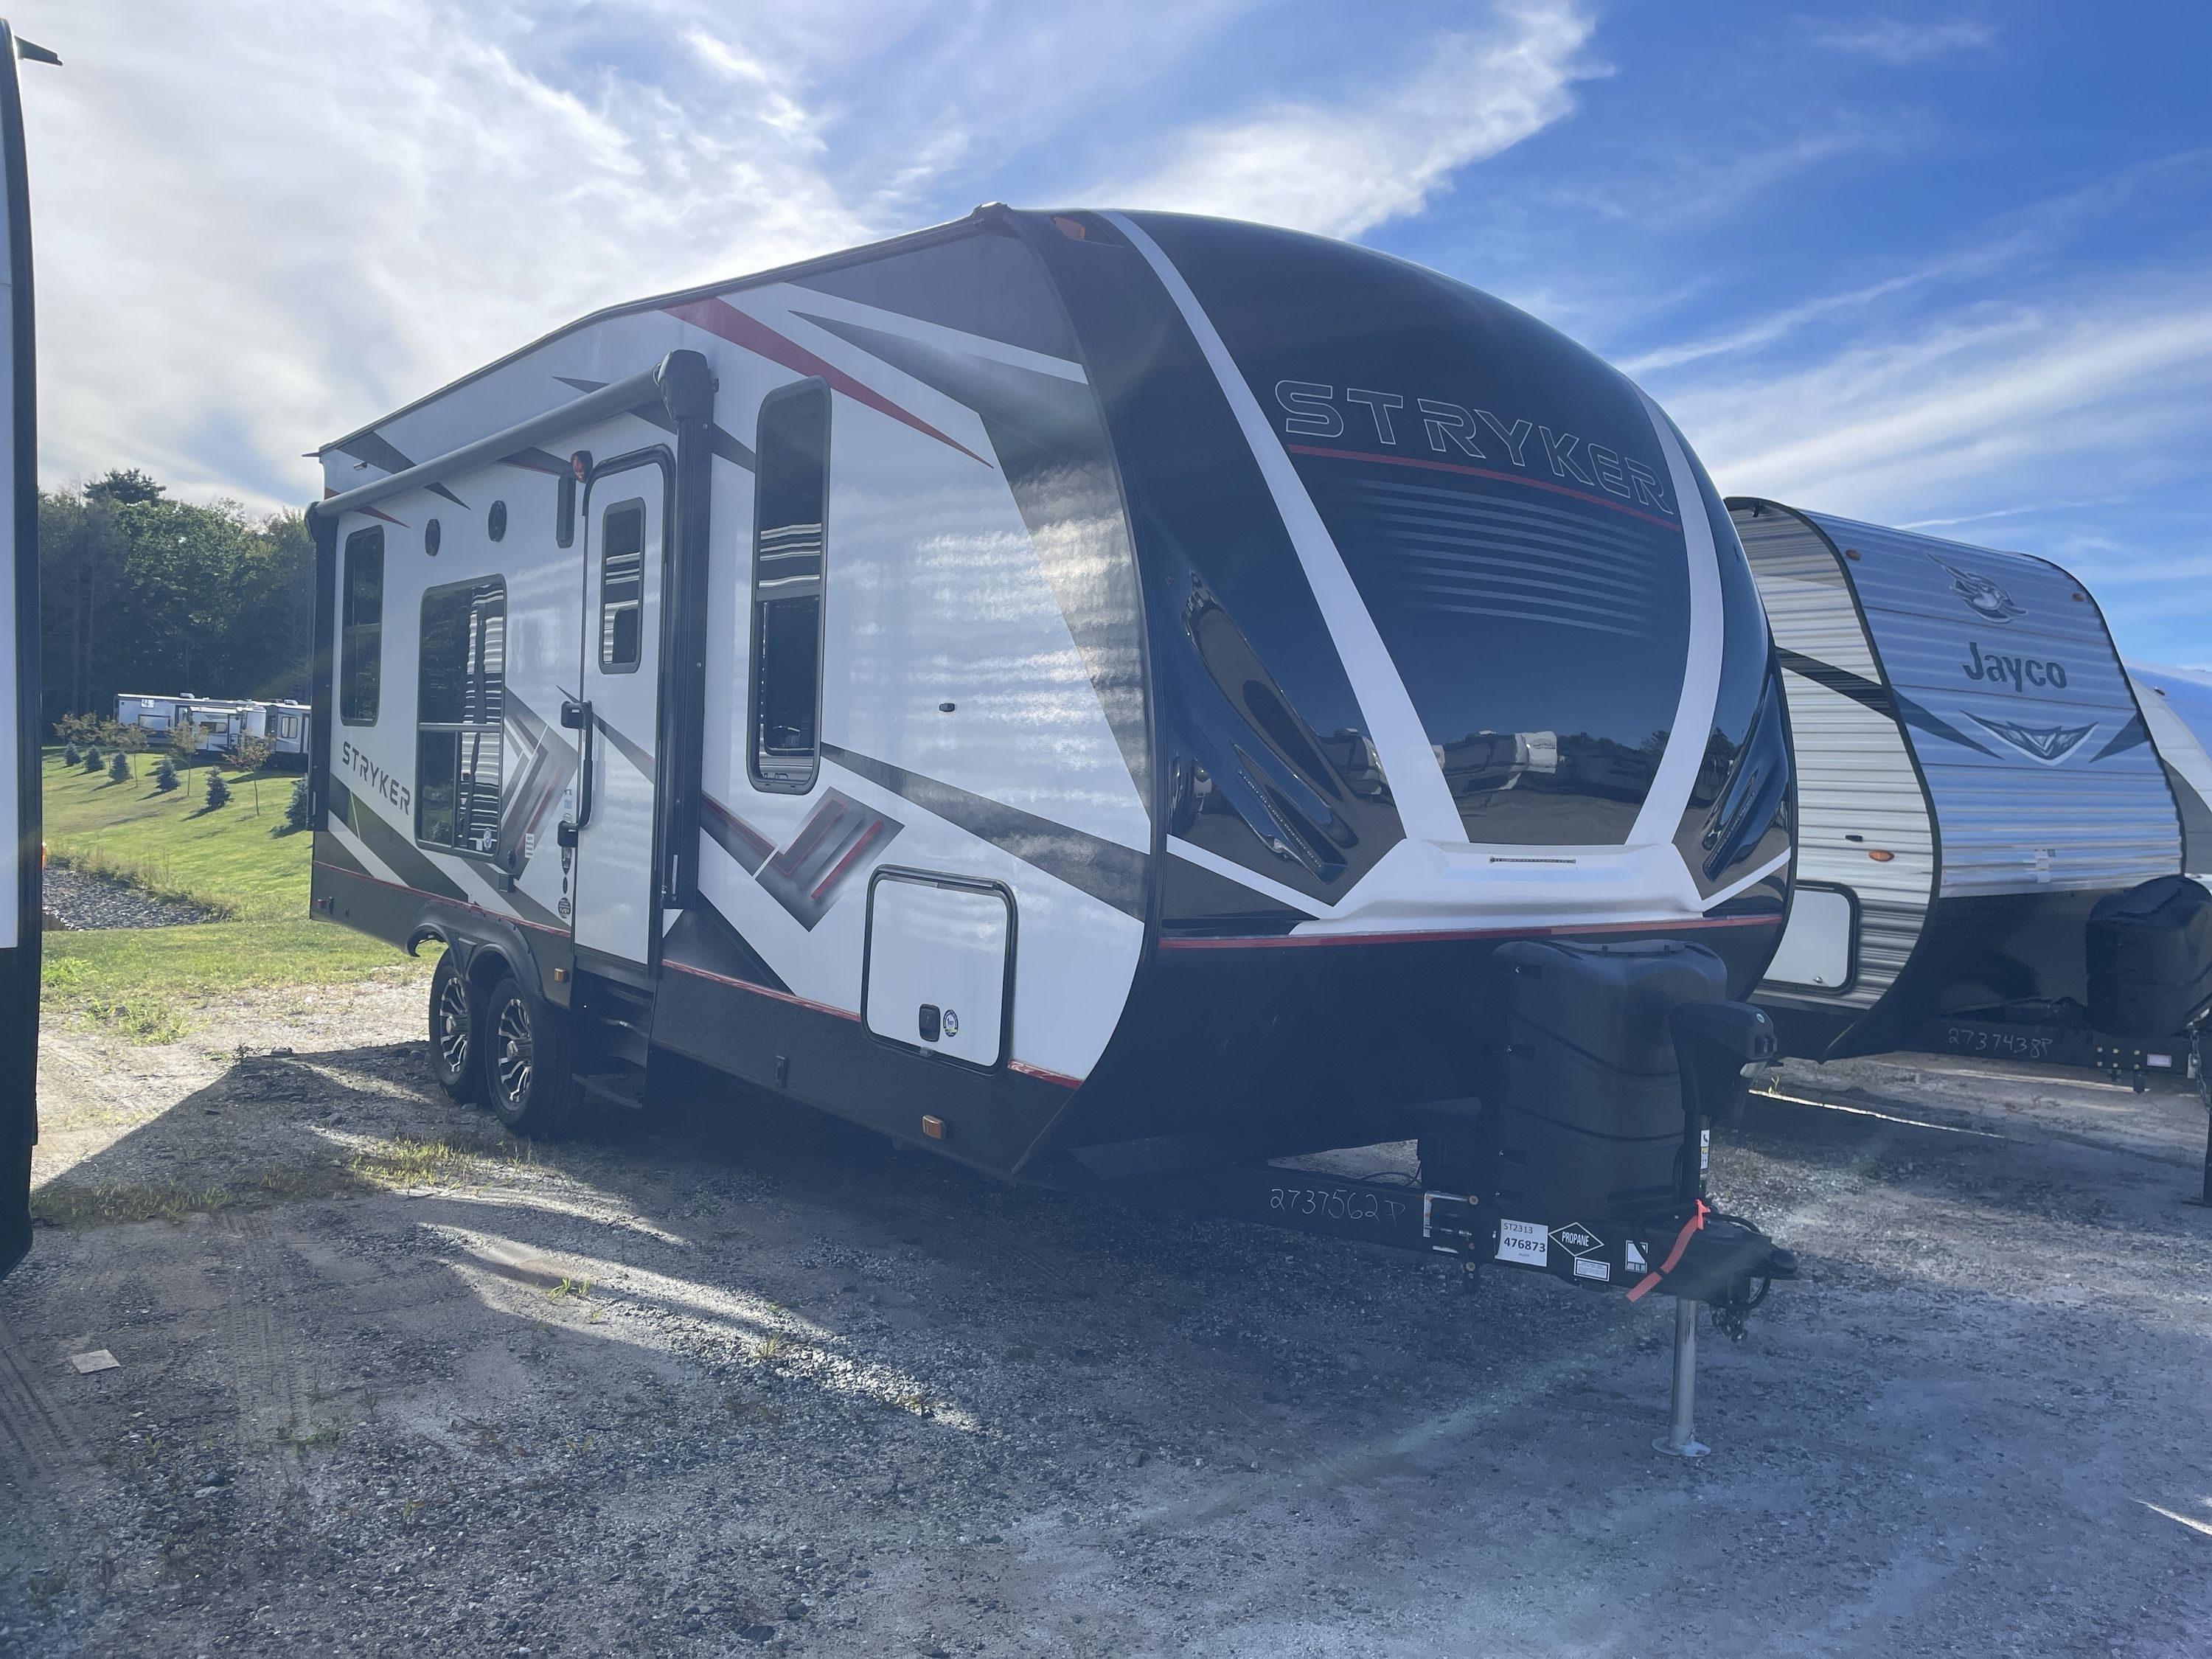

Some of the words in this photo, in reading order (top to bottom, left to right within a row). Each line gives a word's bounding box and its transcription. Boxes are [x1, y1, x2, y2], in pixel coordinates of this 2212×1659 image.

[1275, 380, 1674, 515] STRYKER
[1962, 641, 2067, 692] Jayco
[343, 741, 411, 815] STRYKER
[1948, 1029, 2053, 1059] 2737438P
[1503, 1222, 1534, 1234] ST2313
[1562, 1231, 1590, 1248] PROPANE
[1503, 1237, 1546, 1253] 476873
